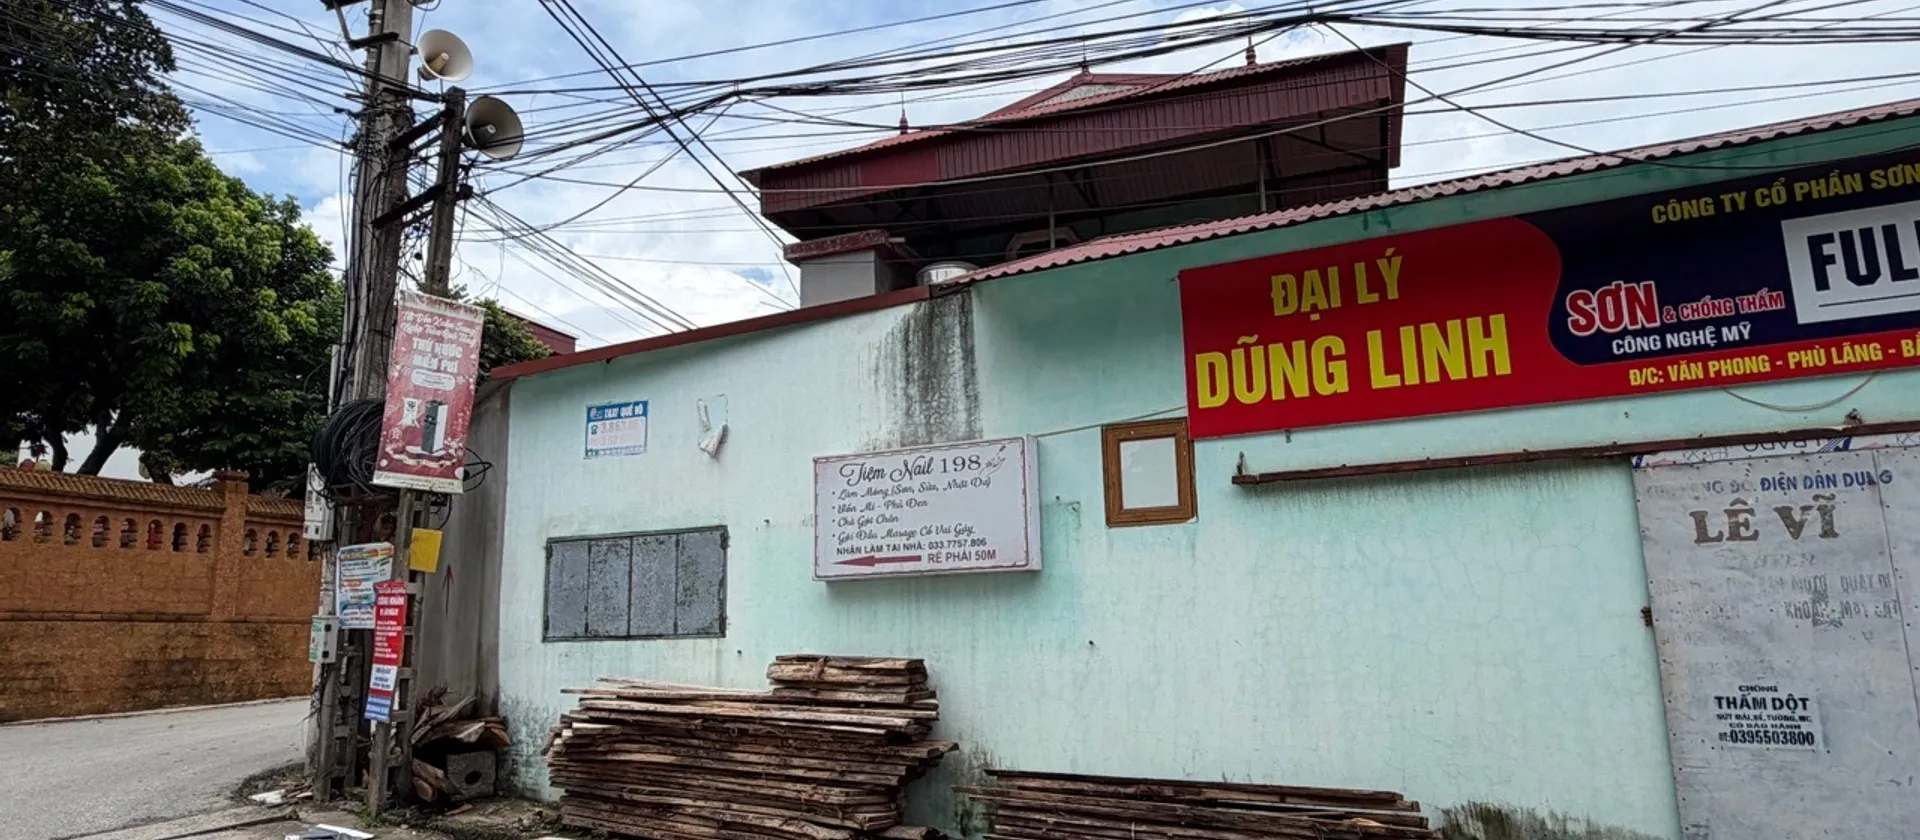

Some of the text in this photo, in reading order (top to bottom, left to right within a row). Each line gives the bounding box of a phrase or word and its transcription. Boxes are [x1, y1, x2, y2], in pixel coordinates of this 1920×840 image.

[1651, 163, 1920, 224] CÔNG TY CỔ PHẦN SƠN
[1806, 219, 1920, 293] FUL
[1271, 247, 1403, 321] ĐẠI LÝ
[1566, 280, 1785, 336] SƠN & CHỐNG THẤM
[1195, 313, 1512, 410] DŨNG LINH
[1612, 320, 1752, 355] CÔNG NGHỆ MỸ
[1629, 366, 1665, 388] Đ/C:
[1667, 358, 1704, 384] VĂN
[1709, 355, 1772, 378] PHONG
[1788, 346, 1828, 371] PHÙ
[1831, 342, 1883, 366] LÃNG
[839, 454, 981, 487] Tiệm Nail 198
[1688, 493, 1841, 545] LÊ VĨ
[864, 543, 884, 553] LÀM
[975, 548, 997, 561] 50M
[1714, 692, 1811, 714] THẤM DỘT
